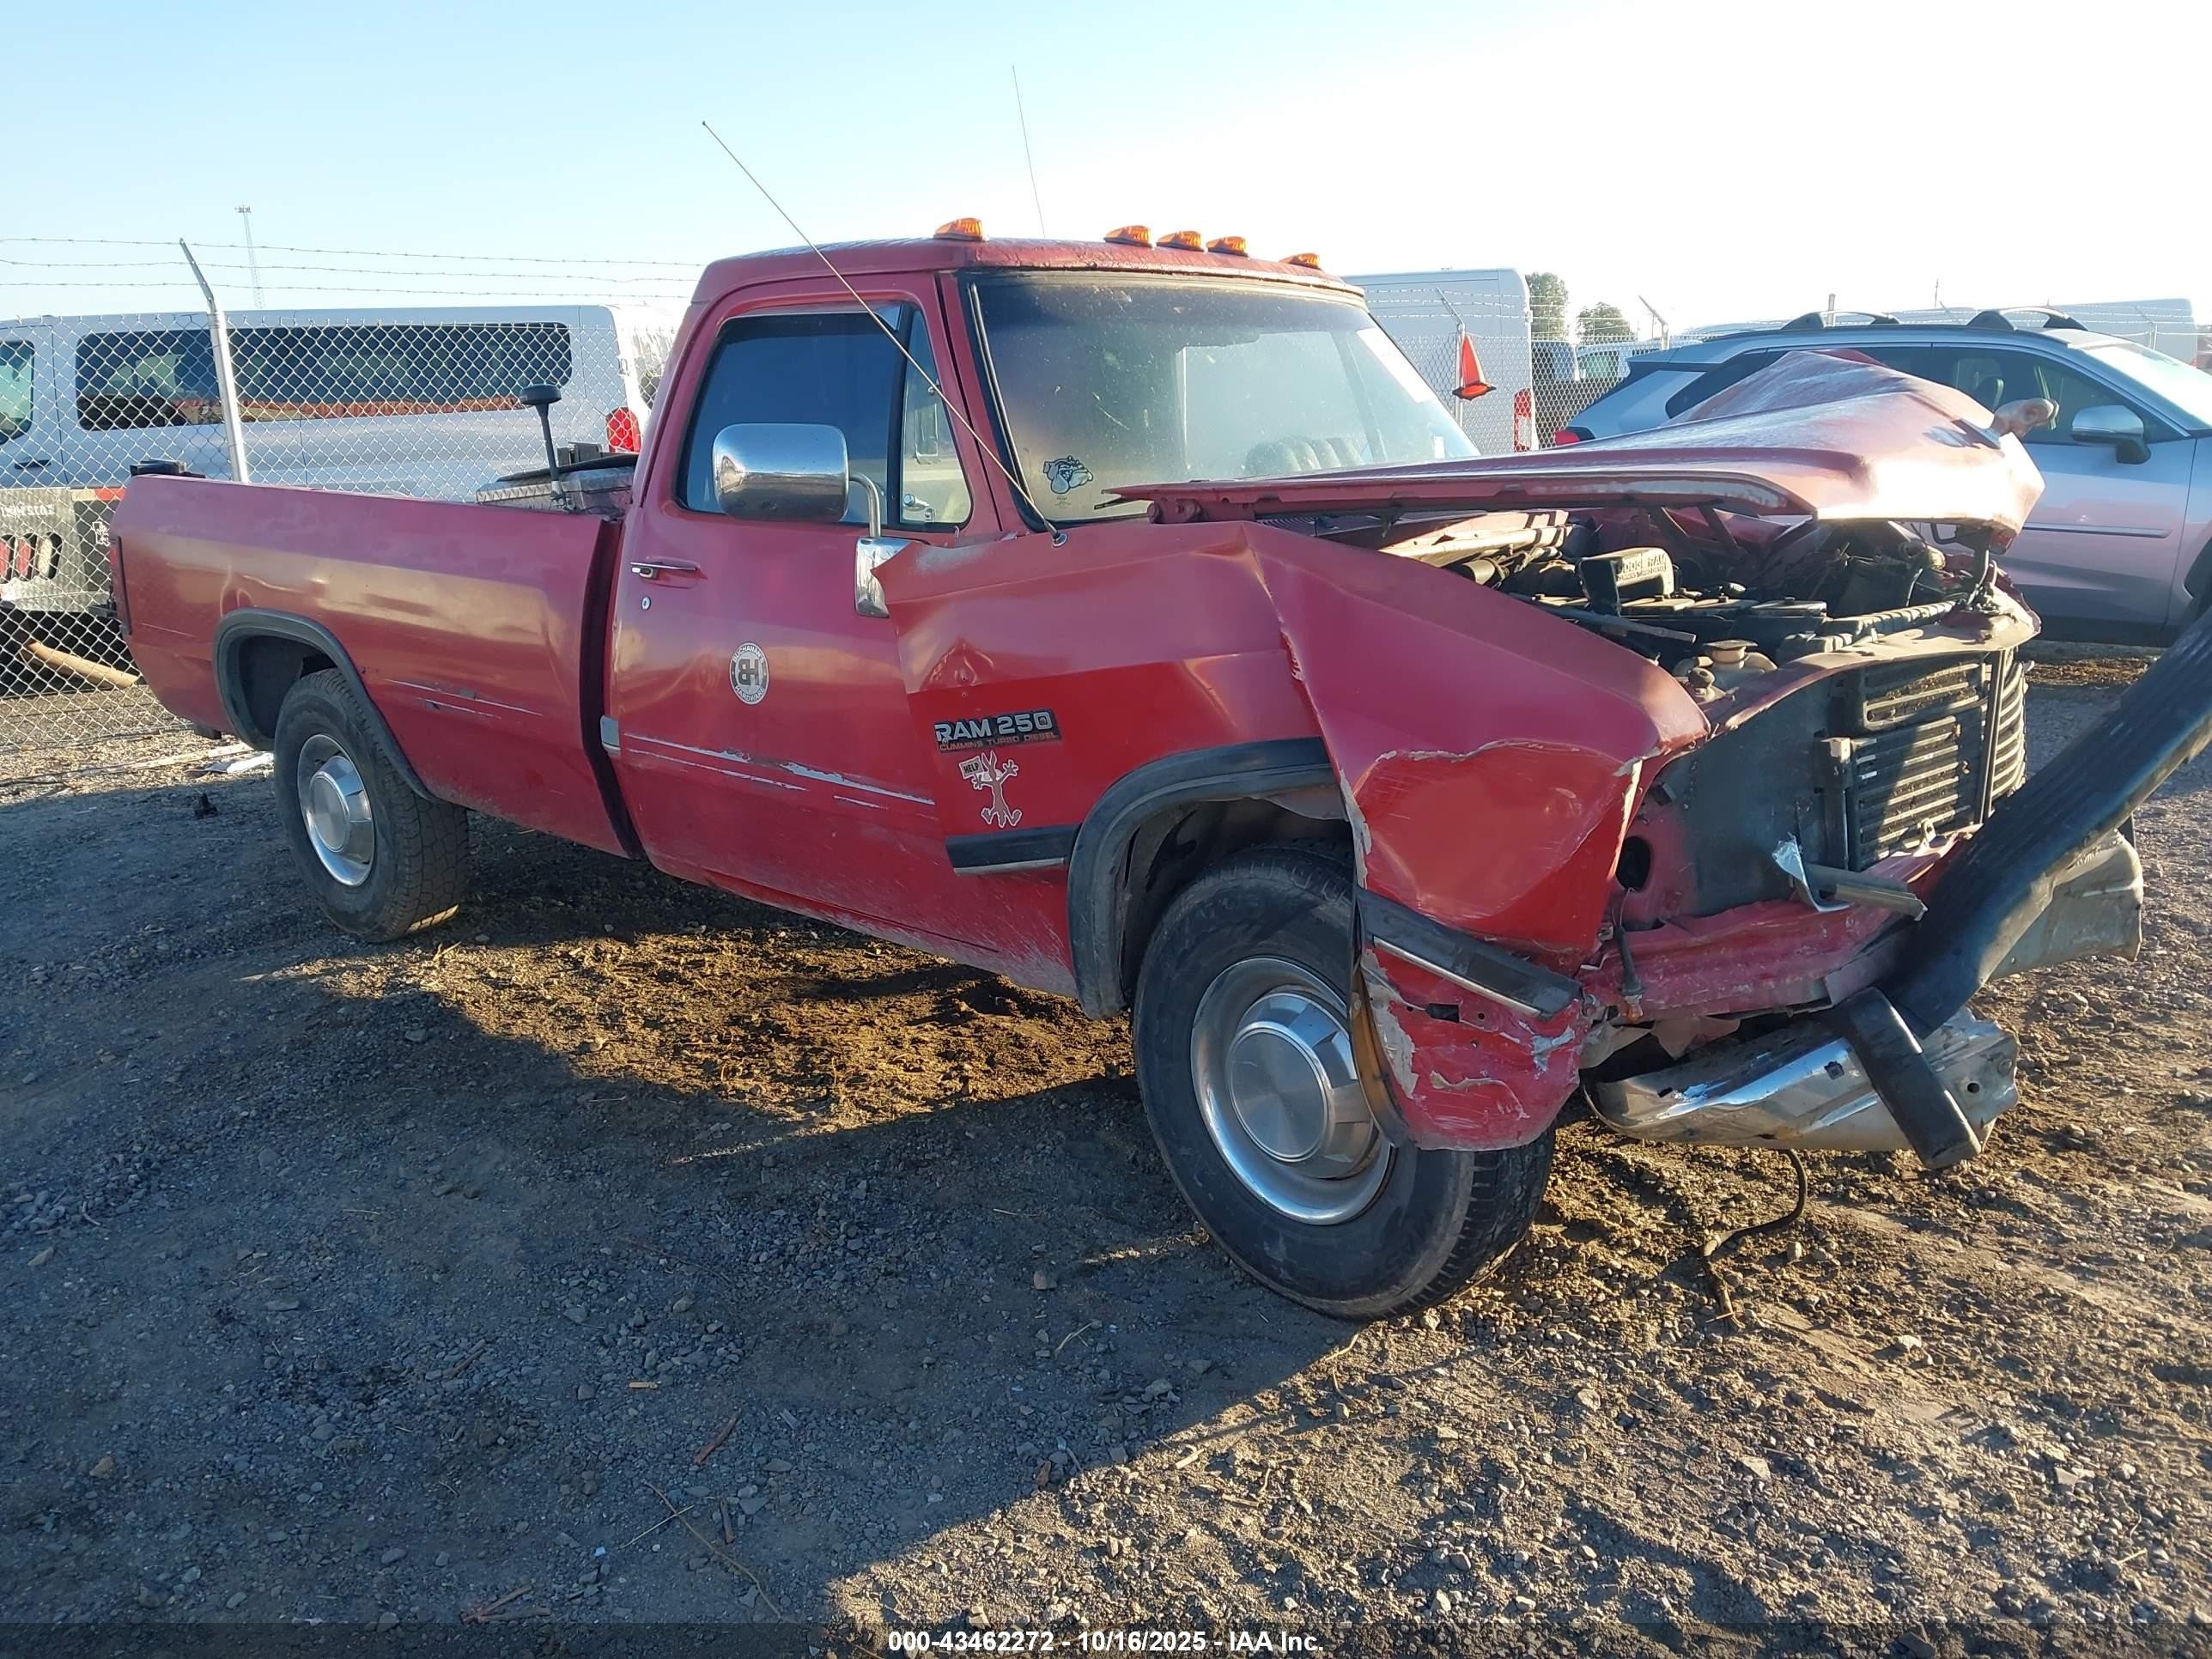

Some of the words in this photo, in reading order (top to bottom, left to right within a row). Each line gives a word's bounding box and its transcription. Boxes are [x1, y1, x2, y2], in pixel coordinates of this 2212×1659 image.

[934, 718, 992, 742] RAM
[997, 712, 1053, 734] 250
[940, 739, 983, 751] CUMMINS
[988, 735, 1020, 746] TURBO
[1024, 732, 1058, 742] DIESEL
[963, 762, 980, 773] HELP
